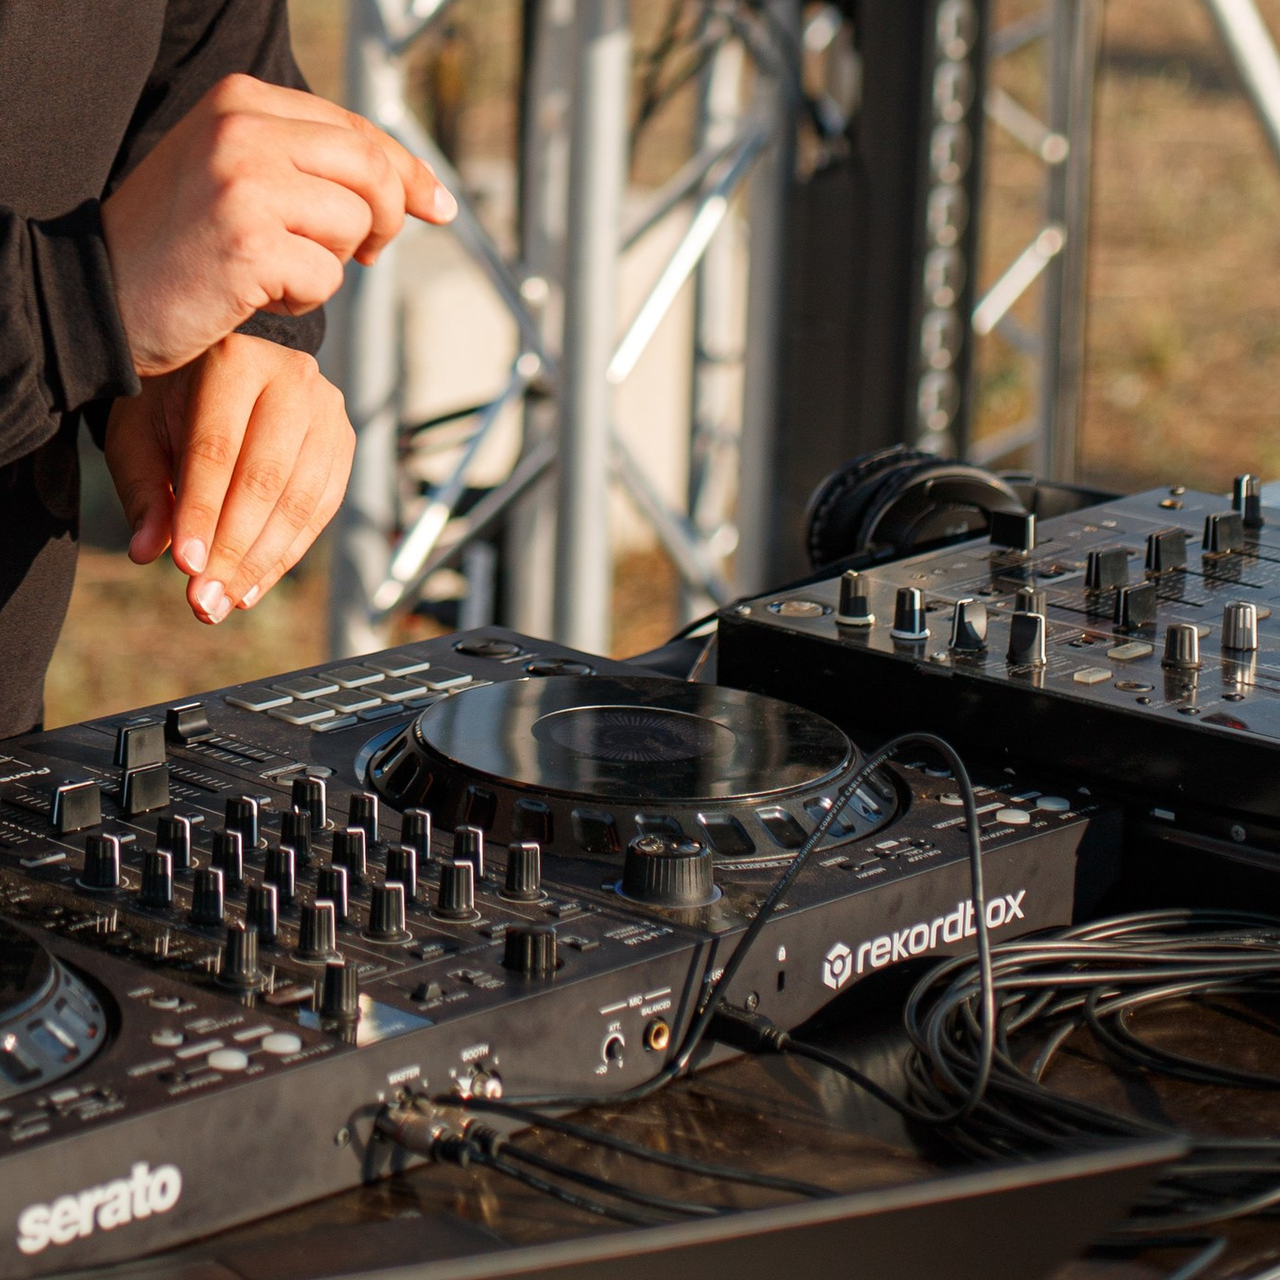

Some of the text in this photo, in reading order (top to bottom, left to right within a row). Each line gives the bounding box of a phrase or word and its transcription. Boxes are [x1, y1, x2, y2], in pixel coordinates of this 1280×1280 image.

[820, 795, 847, 832] COMPUTER
[845, 775, 864, 797] CABLE
[862, 753, 889, 776] VERSION
[856, 889, 1027, 975] rekordbox
[628, 994, 644, 1008] MIC
[641, 1000, 671, 1017] BALANCED
[461, 1043, 490, 1062] BOOTH
[388, 1064, 420, 1085] MASTER
[17, 1161, 182, 1255] serato
